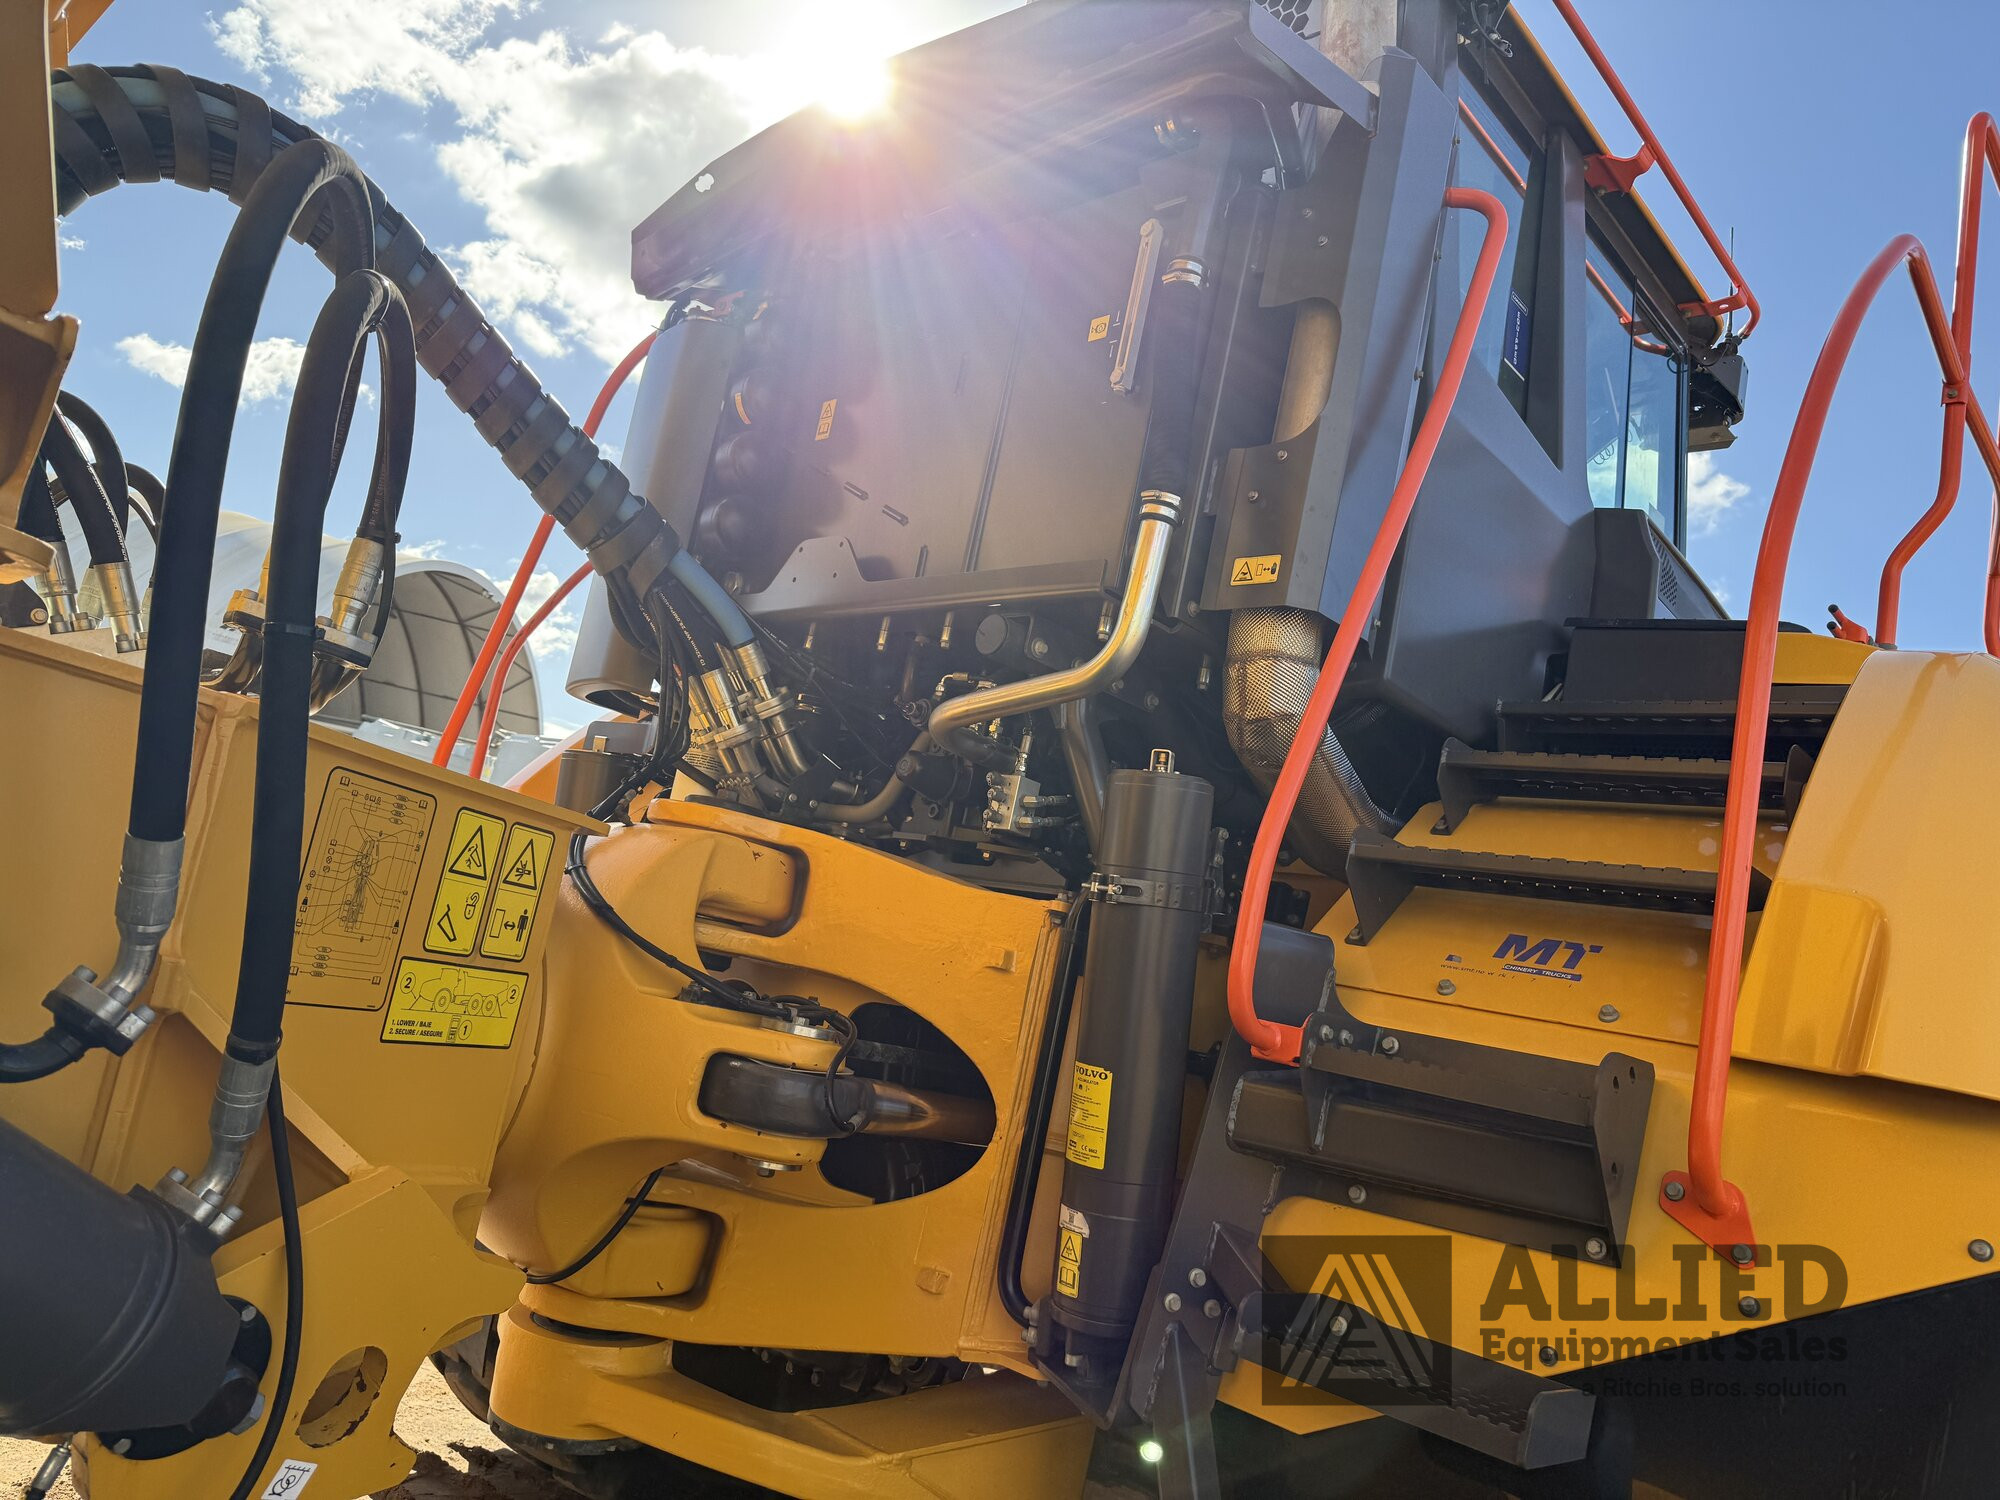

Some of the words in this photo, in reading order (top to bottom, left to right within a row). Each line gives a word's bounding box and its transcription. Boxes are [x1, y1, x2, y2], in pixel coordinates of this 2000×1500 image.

[1504, 964, 1538, 974] CHINERY
[1542, 970, 1572, 979] TRUCKS
[404, 977, 412, 989] 2
[510, 989, 516, 999] 2
[394, 1028, 416, 1036] SECURE
[463, 1025, 468, 1036] 1
[1075, 1065, 1108, 1080] VOLVO
